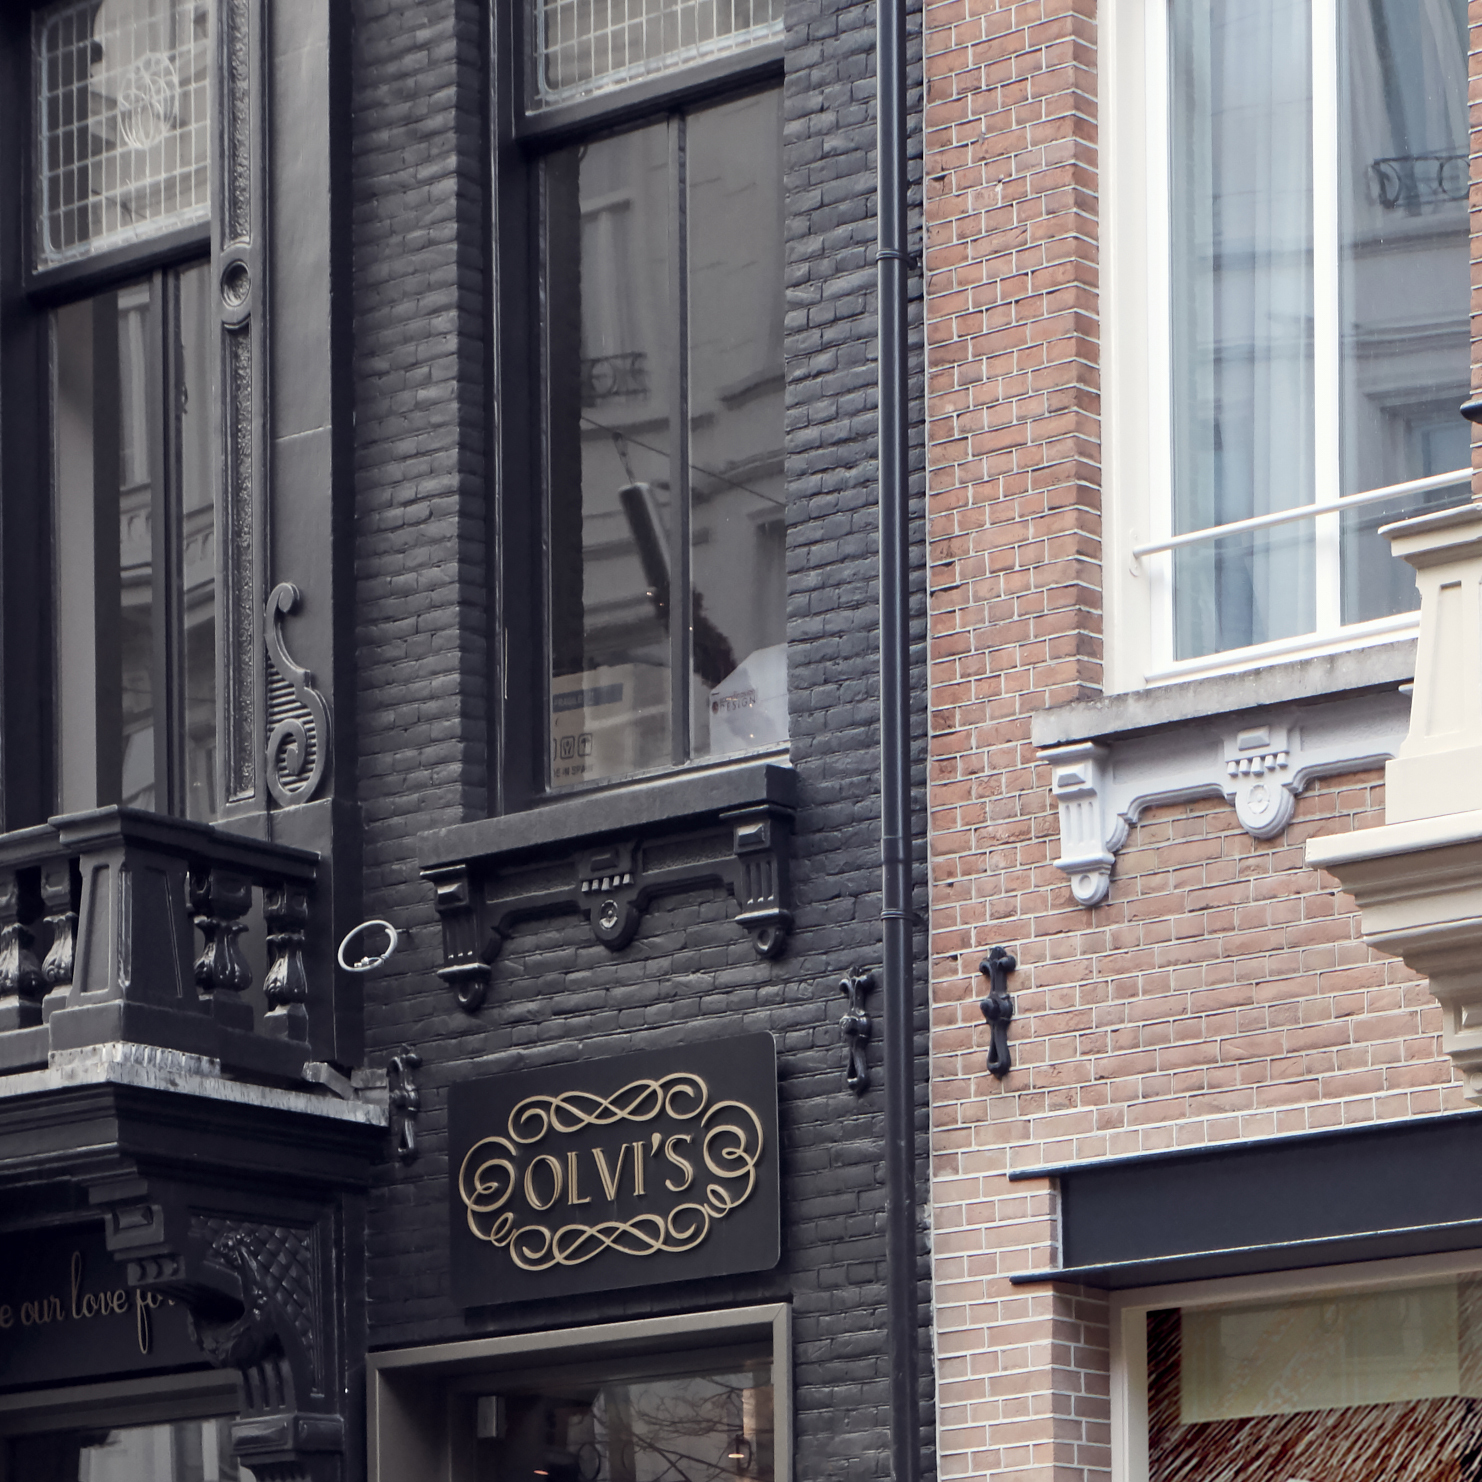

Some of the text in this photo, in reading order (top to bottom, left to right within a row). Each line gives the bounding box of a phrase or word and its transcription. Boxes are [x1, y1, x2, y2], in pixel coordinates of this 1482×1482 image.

[524, 1132, 694, 1210] OLVI'S
[20, 1294, 66, 1326] our
[71, 1251, 129, 1319] love
[136, 1288, 176, 1354] fo
